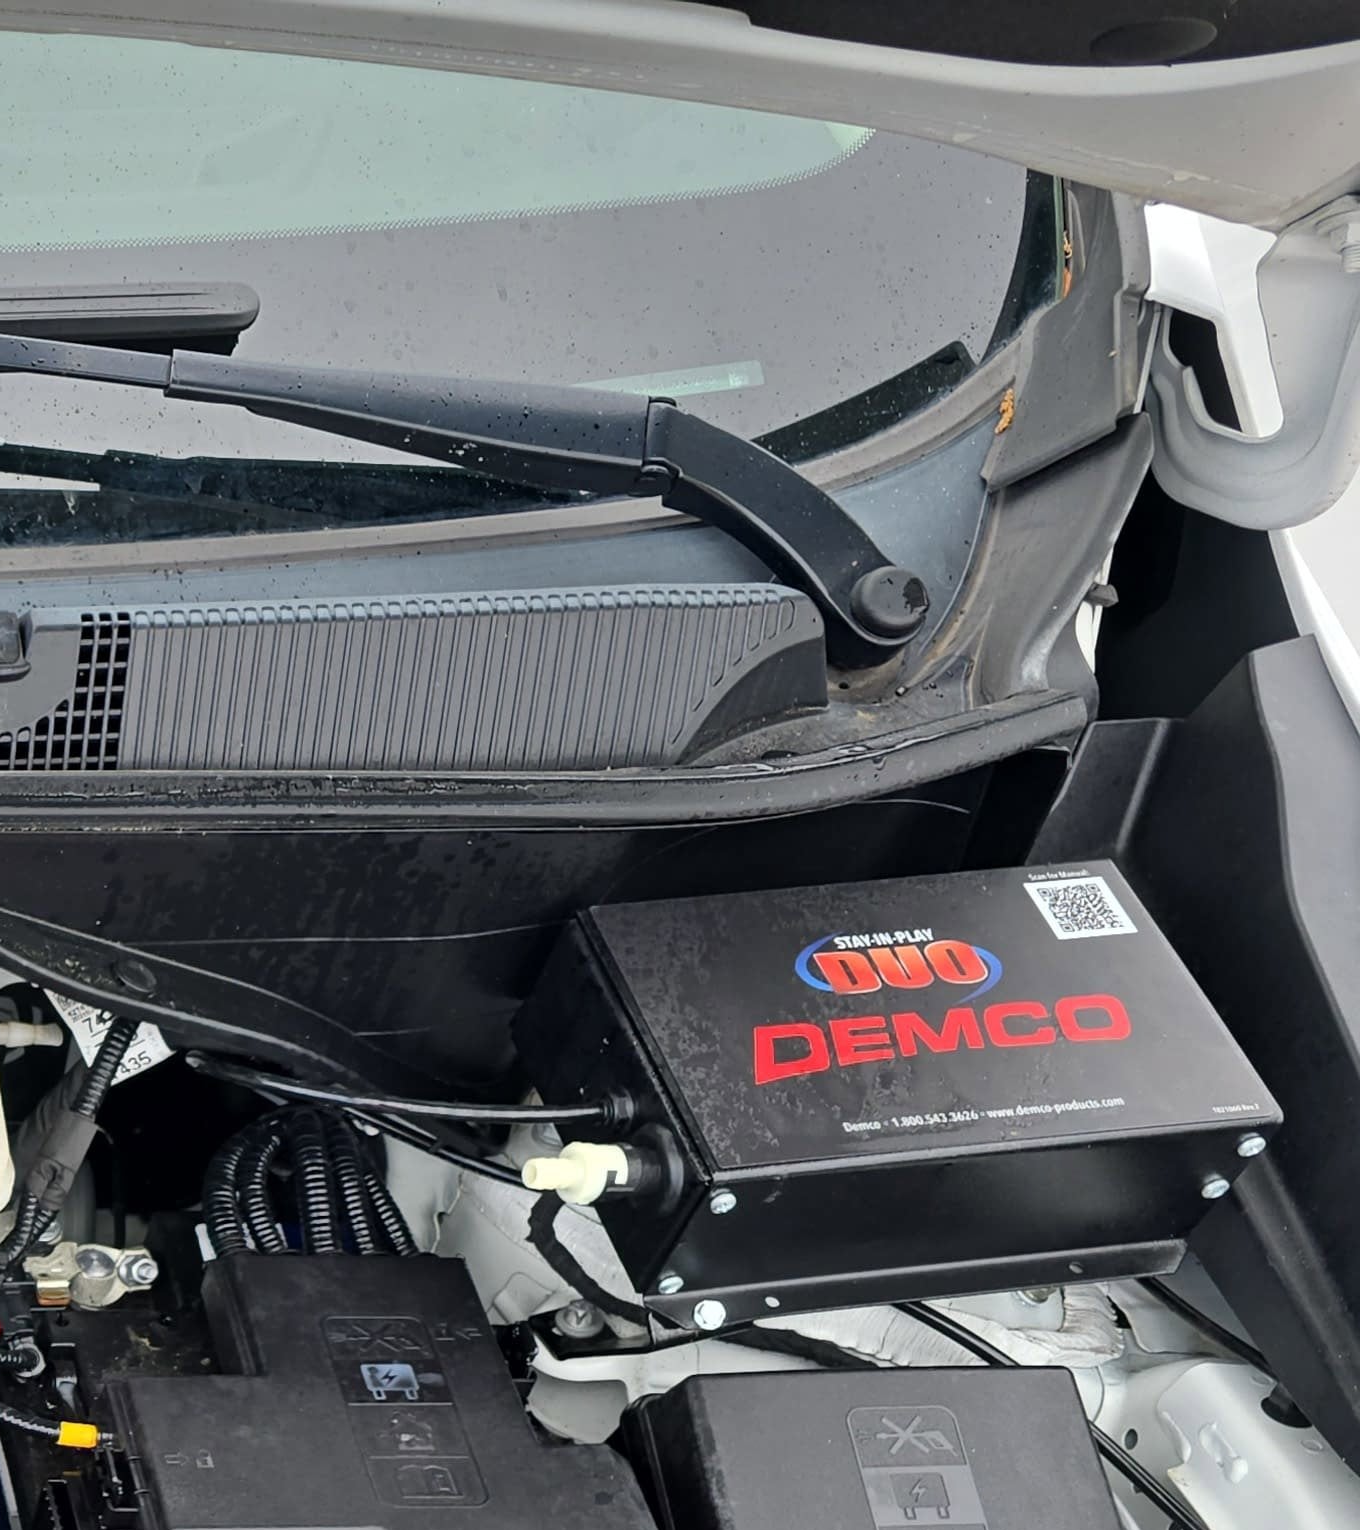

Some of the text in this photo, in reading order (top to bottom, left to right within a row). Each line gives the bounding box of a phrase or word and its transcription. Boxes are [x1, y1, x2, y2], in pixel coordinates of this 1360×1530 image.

[833, 927, 935, 950] STAY-IN-PLAY
[813, 939, 990, 995] DUO
[754, 994, 1132, 1085] DEMCO
[842, 1097, 1125, 1133] Demco 1.800.543.3626 www.demco-products.com
